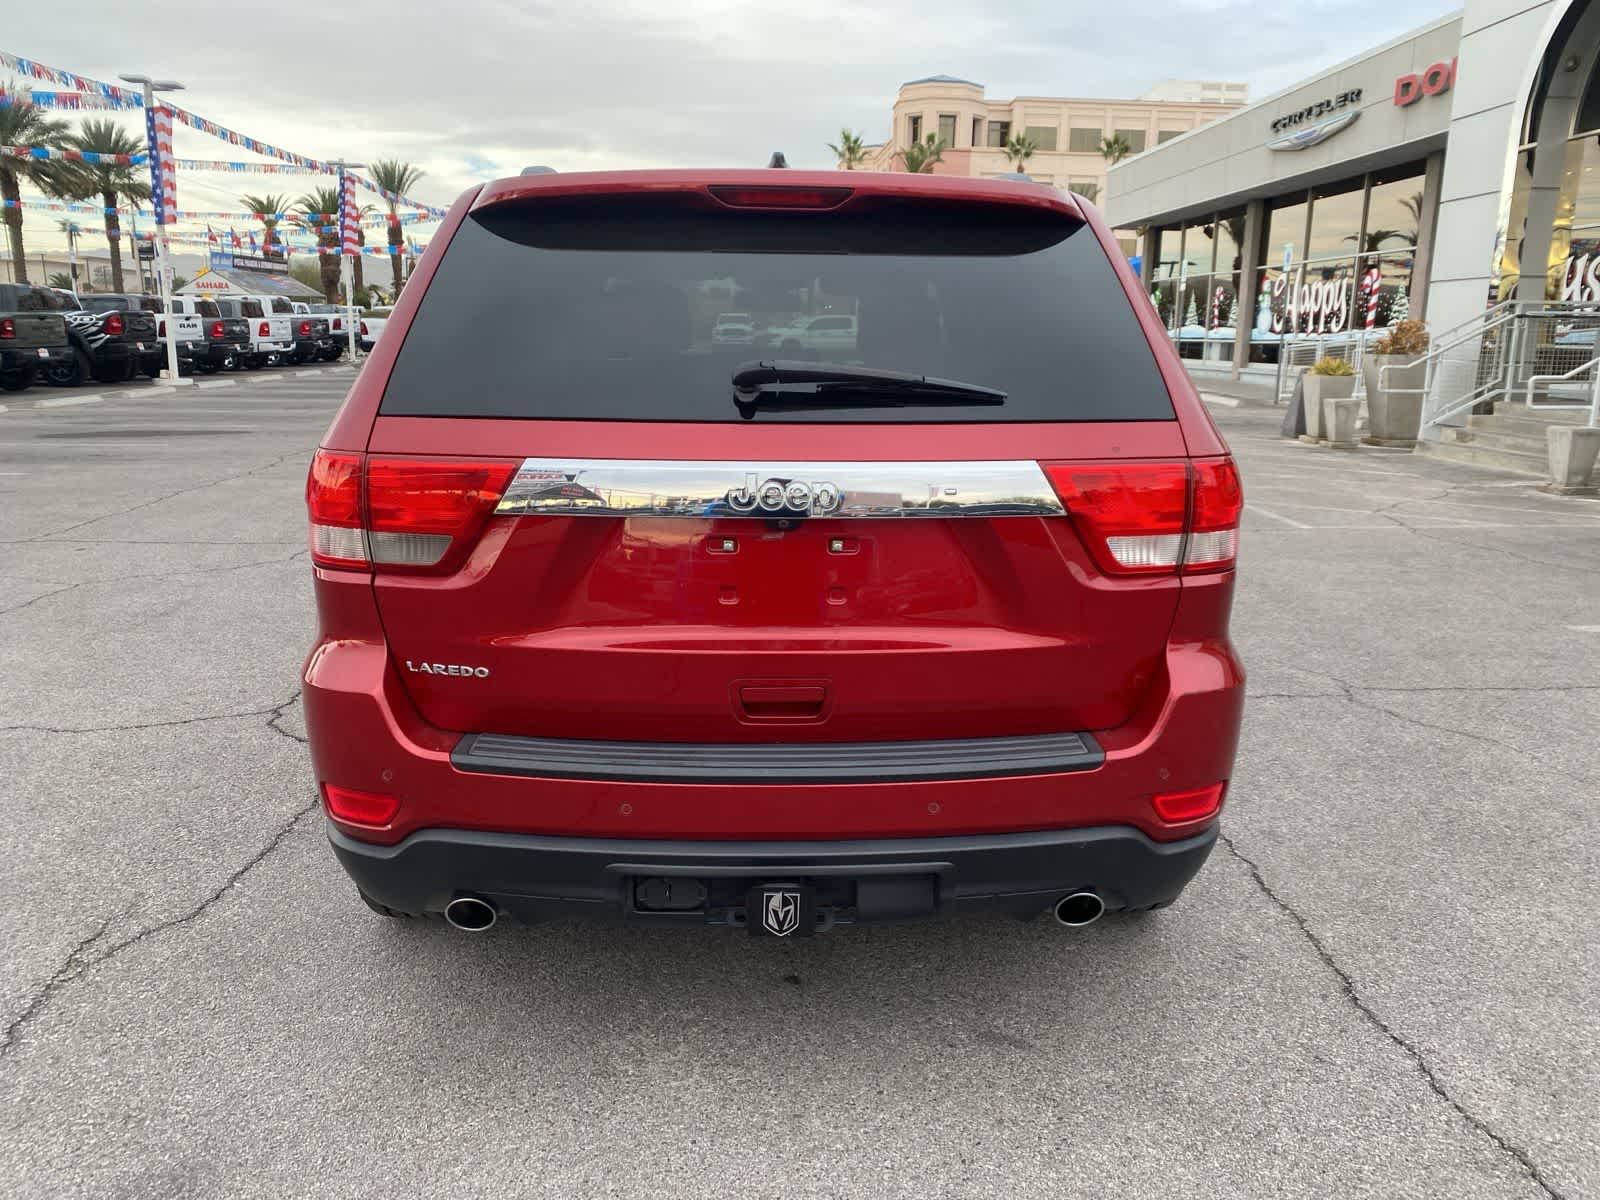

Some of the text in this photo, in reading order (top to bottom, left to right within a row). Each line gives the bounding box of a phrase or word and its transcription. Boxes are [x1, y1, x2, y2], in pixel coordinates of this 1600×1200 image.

[195, 281, 229, 290] SAHARA
[1273, 267, 1348, 336] Happy
[727, 472, 842, 516] Jeep
[405, 660, 490, 678] LAREDO
